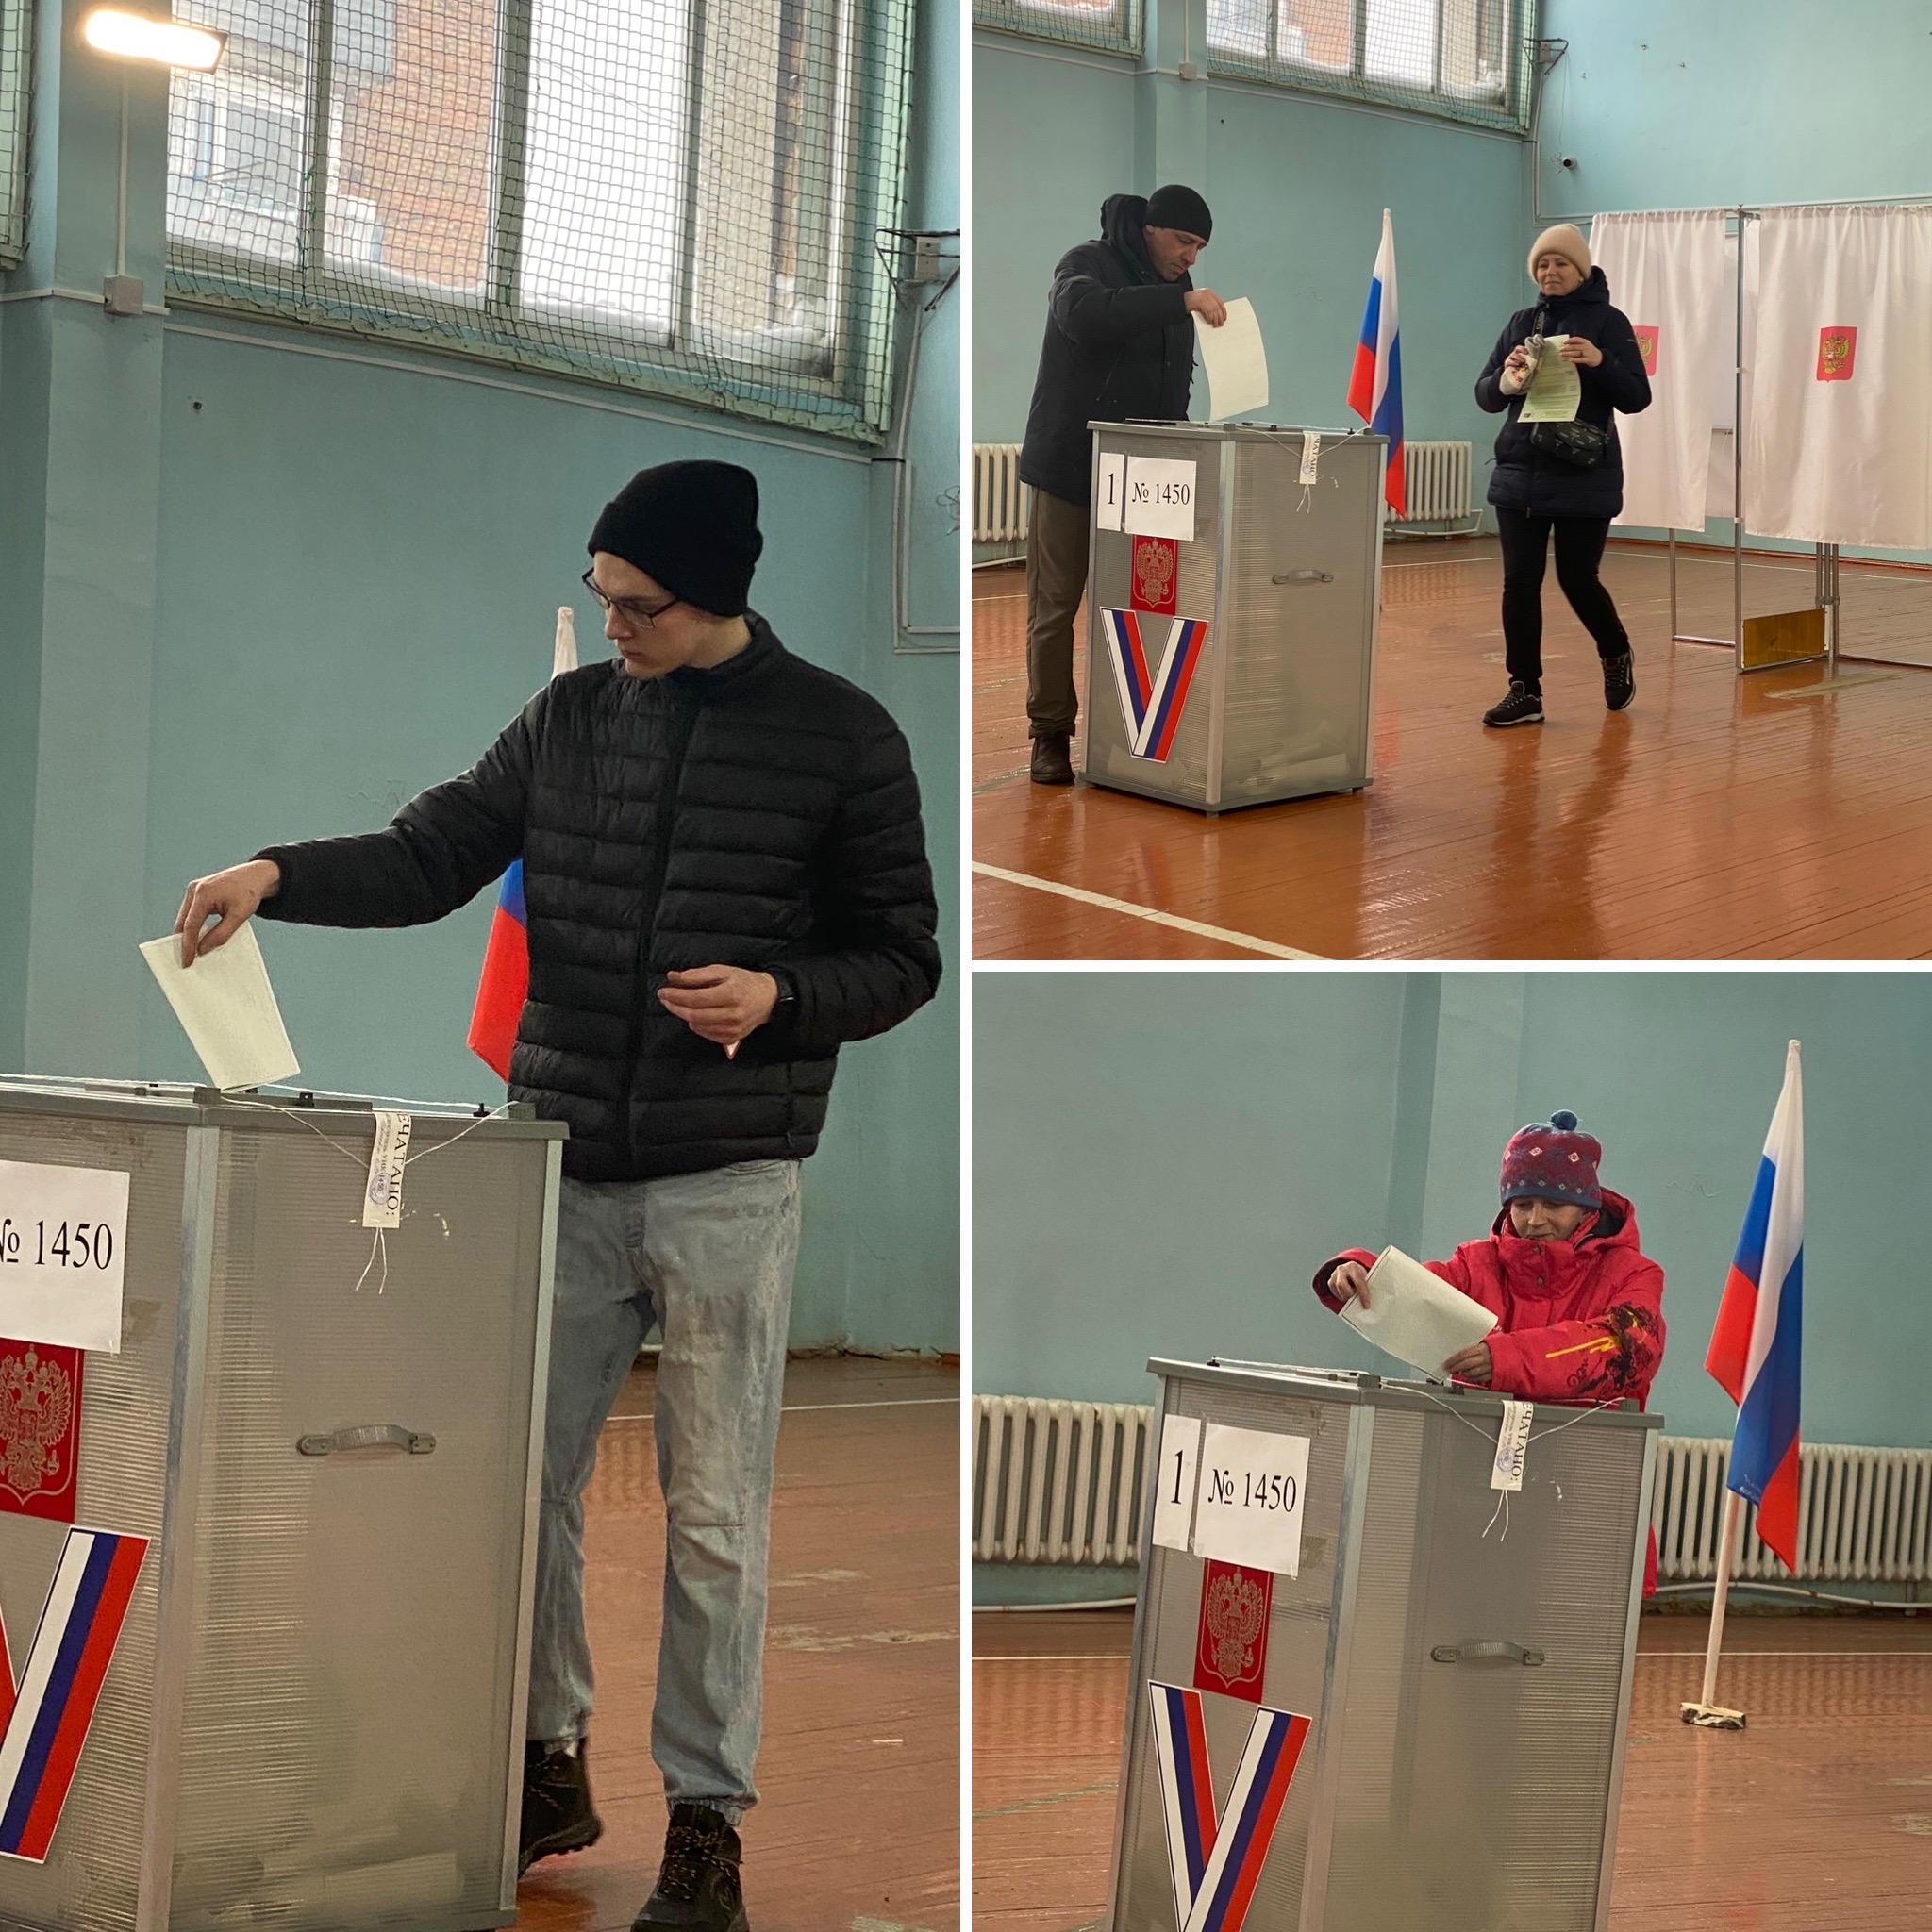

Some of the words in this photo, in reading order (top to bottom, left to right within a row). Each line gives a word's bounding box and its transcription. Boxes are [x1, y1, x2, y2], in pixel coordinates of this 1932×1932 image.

[1108, 473, 1115, 505] 1
[1132, 482, 1149, 503] №
[1156, 483, 1191, 505] 1450
[35, 1220, 112, 1270] 1450
[1171, 1449, 1183, 1505] 1
[1208, 1469, 1234, 1504] №
[1243, 1472, 1296, 1512] 1450
